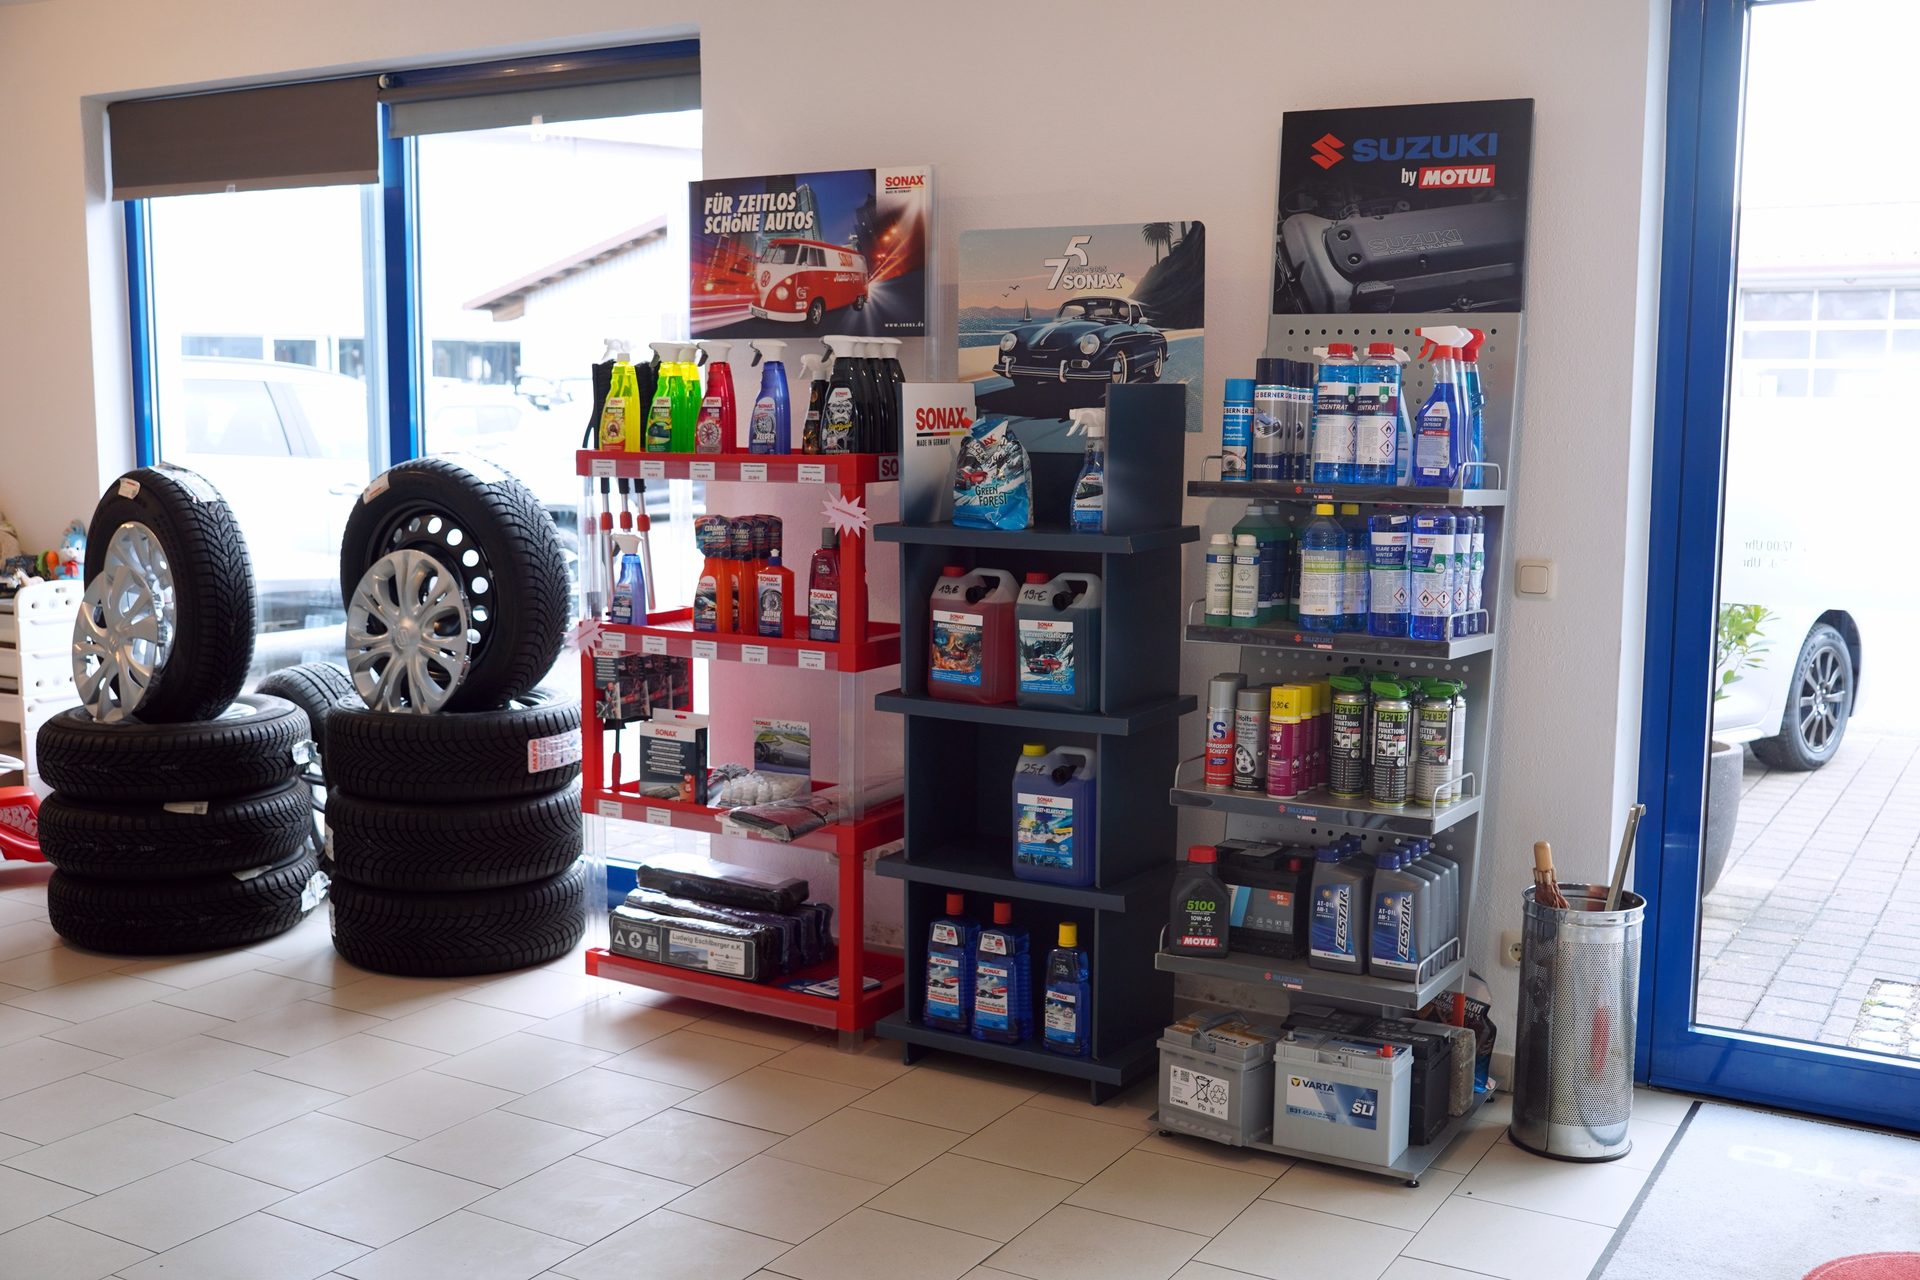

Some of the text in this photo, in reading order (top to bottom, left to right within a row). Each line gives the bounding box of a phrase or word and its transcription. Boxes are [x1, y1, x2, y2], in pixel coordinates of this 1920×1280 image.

[1352, 132, 1498, 162] SUZUKI
[885, 175, 924, 187] SONAX
[1401, 168, 1492, 186] by MOTUL
[704, 191, 797, 216] FÜR ZEITLOS
[704, 210, 814, 234] SCHÖNE AUTOS
[1368, 229, 1462, 251] SUZUKI
[1062, 274, 1122, 290] SONAX
[916, 407, 967, 430] SONAX
[975, 484, 998, 496] GREEN
[979, 492, 1013, 509] FOREST
[1334, 705, 1362, 714] PETEC
[1420, 710, 1448, 721] PETEC
[1380, 712, 1407, 722] PETEC
[656, 728, 678, 737] SONAX
[1187, 900, 1216, 911] 5100
[1336, 888, 1350, 952] ECSTAR
[1398, 896, 1412, 960] ECSTAR
[1184, 937, 1217, 946] MOTUL
[936, 958, 952, 966] SONAX
[1303, 1080, 1334, 1092] VARTA
[1198, 1103, 1207, 1111] Pb
[1352, 1103, 1374, 1116] SLI
